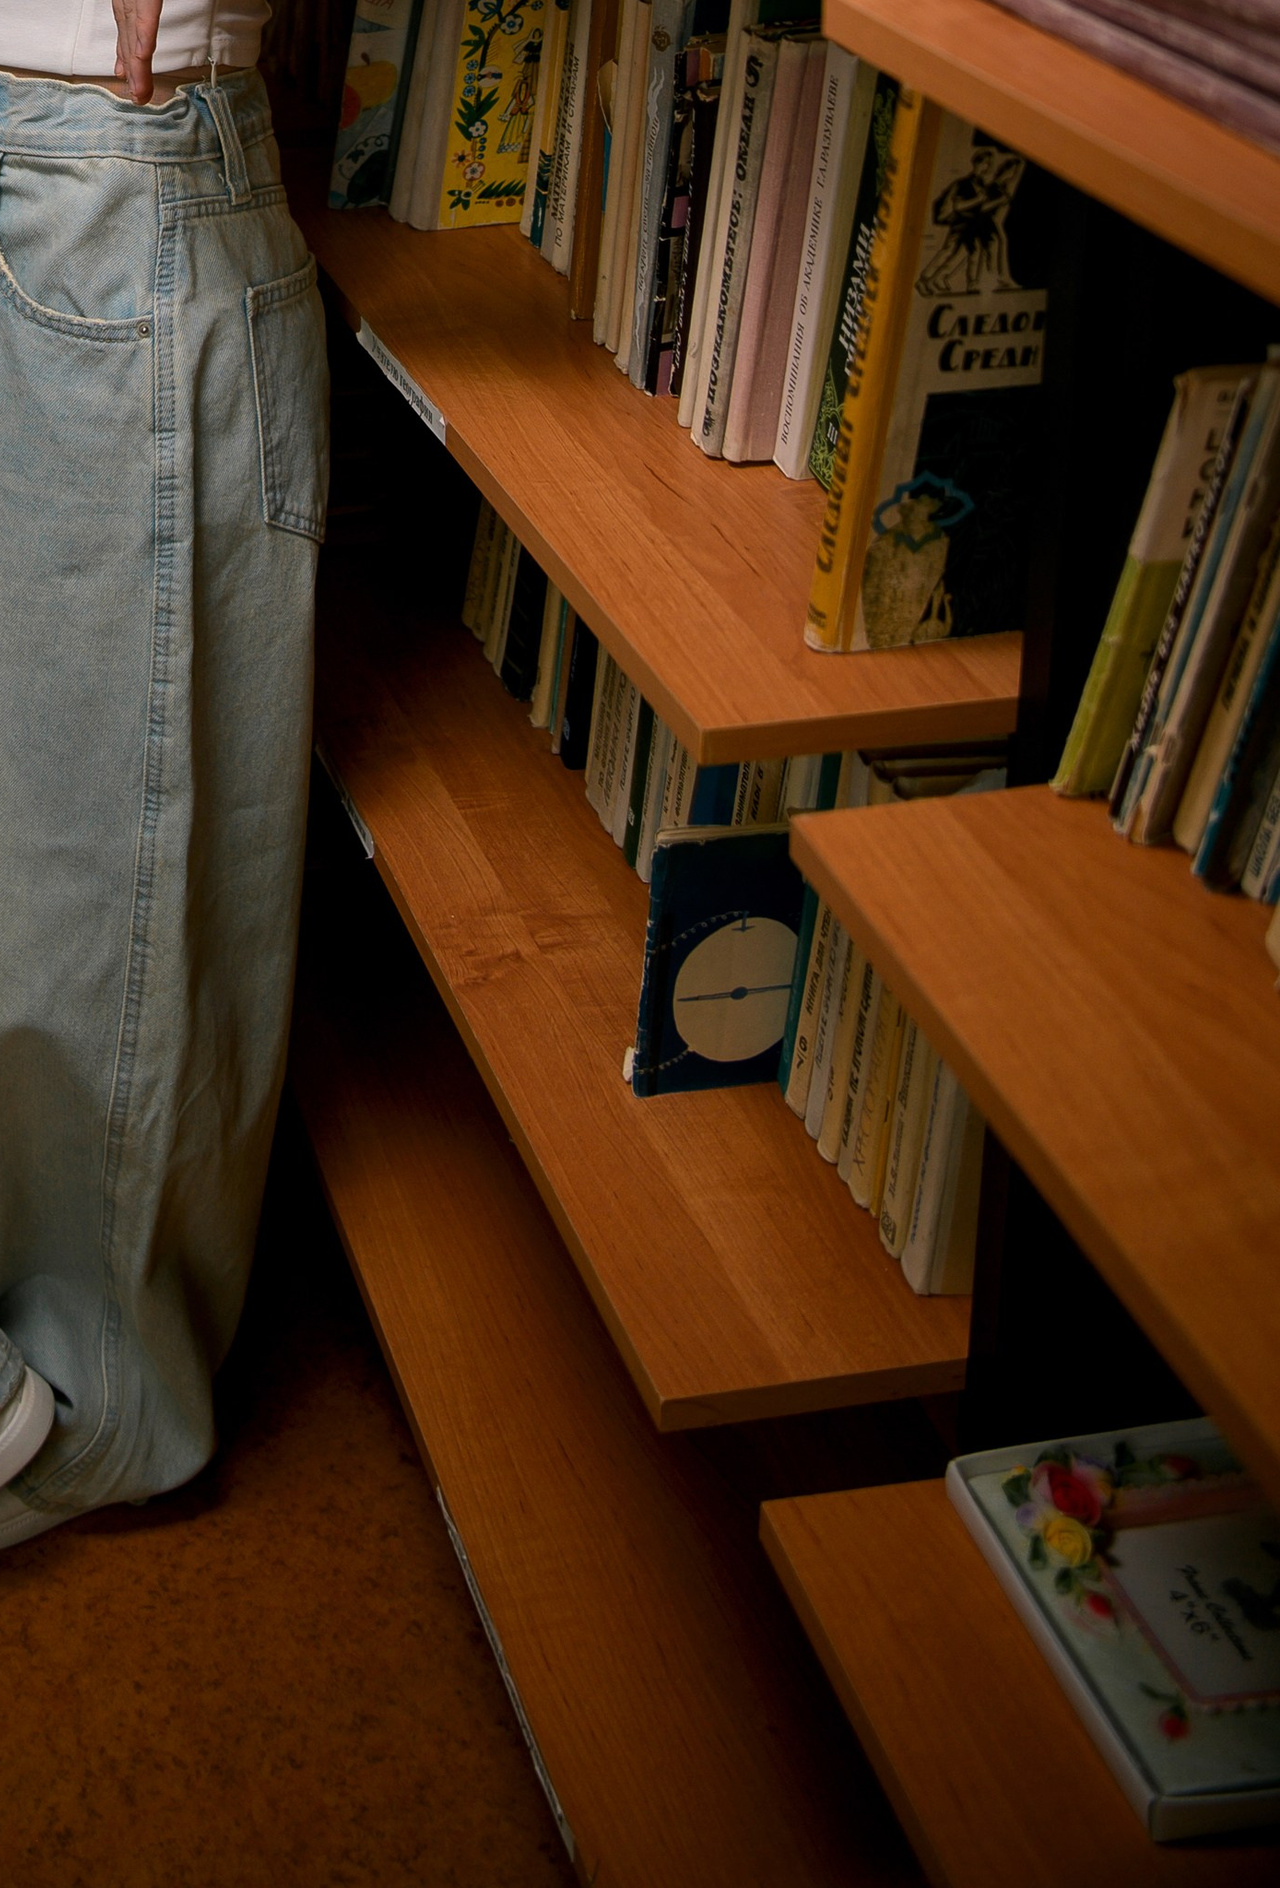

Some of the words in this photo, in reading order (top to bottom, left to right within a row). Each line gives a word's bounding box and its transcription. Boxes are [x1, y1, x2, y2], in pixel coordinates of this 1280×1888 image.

[557, 136, 571, 223] МАТЕРИКАМ
[567, 56, 579, 117] СТРАНАМ
[705, 190, 743, 405] ПОЗНАКОМЬТЕСЬ:
[733, 95, 755, 181] ОКЕАН
[800, 197, 823, 290] АКАДЕМИКЕ
[835, 221, 872, 351] НИЗАМИ
[798, 293, 808, 315] ОБ
[371, 334, 399, 382] Учителю
[399, 374, 433, 425] географии
[779, 321, 805, 444] ВОСПОМИНАНИЯ
[812, 940, 826, 971] ДЛЯ
[818, 905, 833, 939] ЧТЕН
[803, 971, 820, 1015] КНИГА
